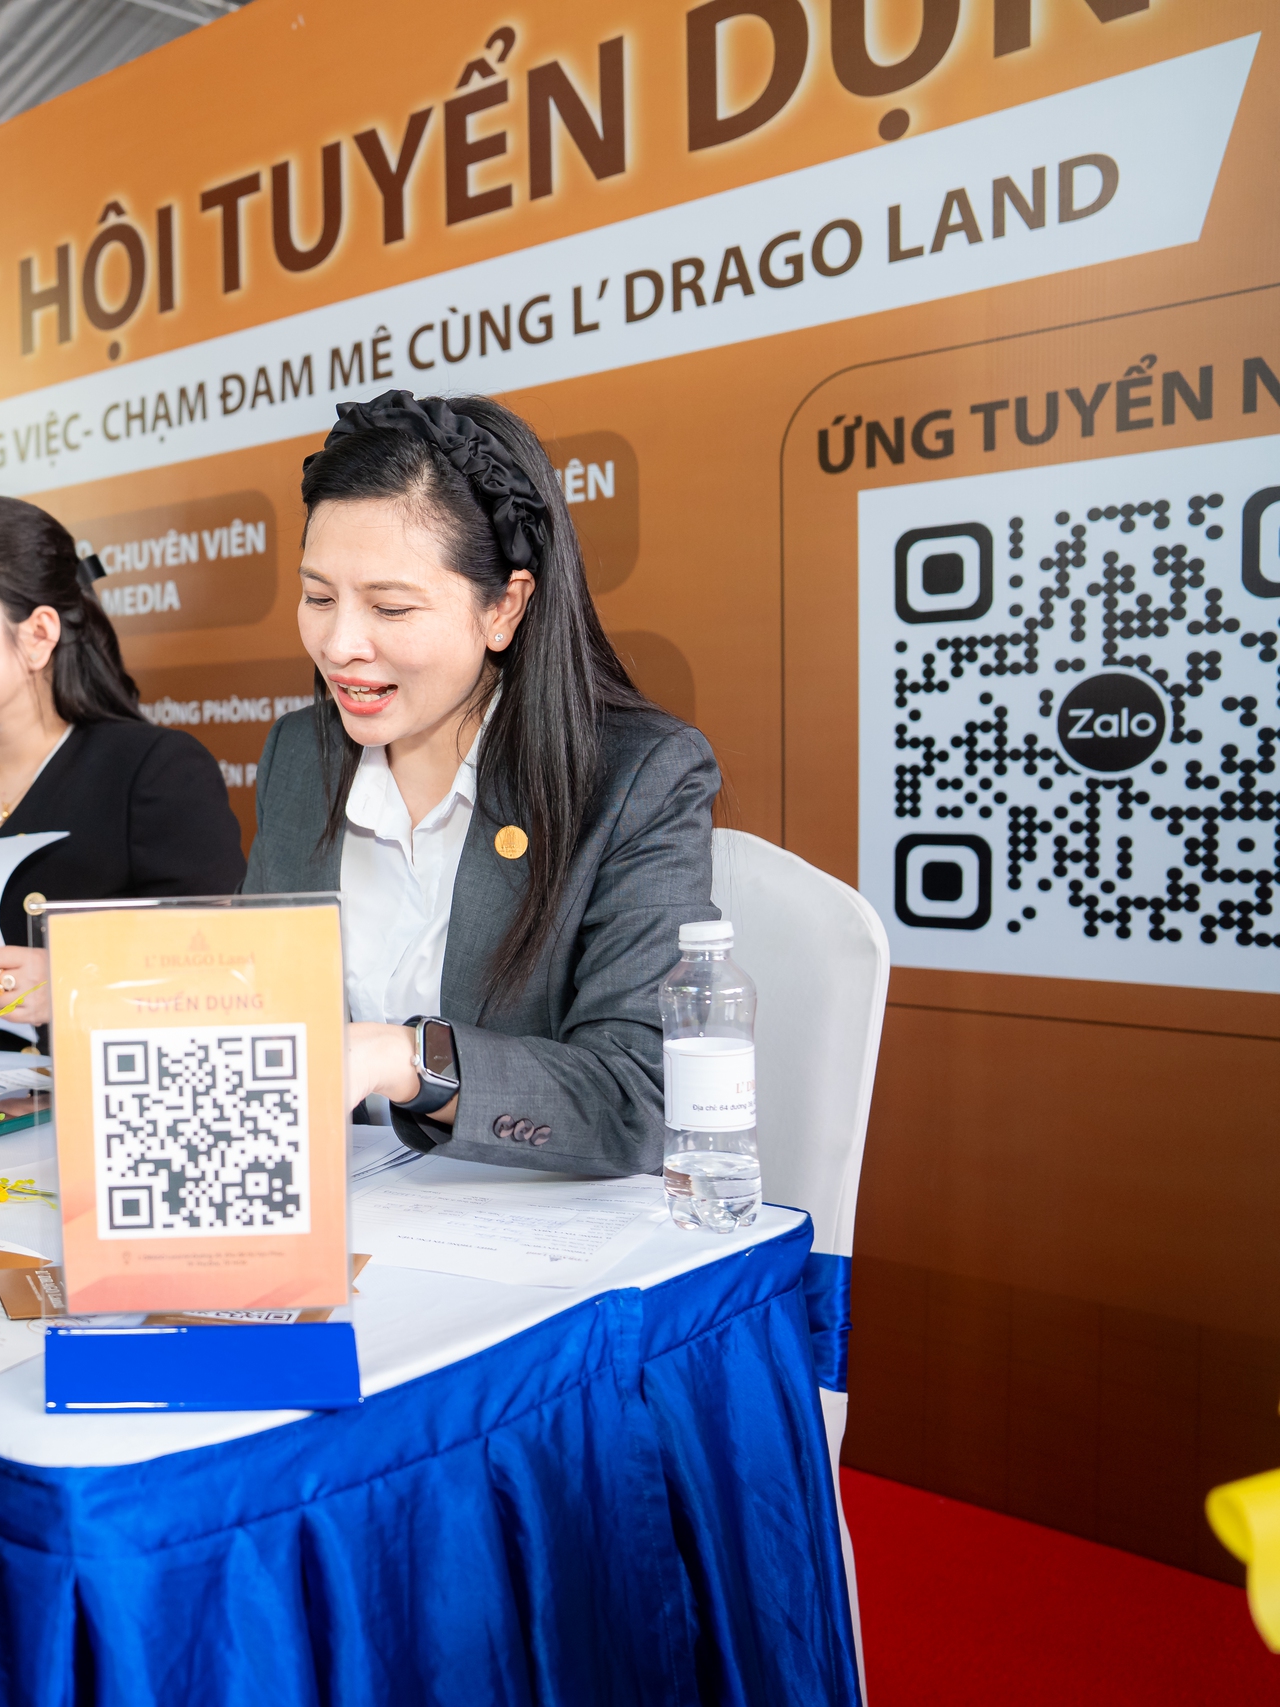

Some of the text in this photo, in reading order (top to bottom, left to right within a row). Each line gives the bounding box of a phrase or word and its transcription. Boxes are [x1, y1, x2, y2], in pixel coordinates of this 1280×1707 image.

[19, 200, 176, 362] HỘI
[200, 26, 626, 294] TUYỂN
[101, 381, 208, 445] CHẠM
[220, 356, 315, 417] ĐAM
[328, 325, 394, 391] MÊ
[407, 294, 554, 370] CÙNG
[624, 219, 863, 323] DRAGO
[887, 153, 1120, 263] LAND
[817, 413, 955, 475] ỨNG
[969, 353, 1214, 452] TUYỂN
[100, 529, 199, 575] CHUYÊN
[202, 518, 266, 561] VIÊN
[101, 580, 180, 616] MEDIA
[202, 694, 270, 723] PHÒNG
[1066, 706, 1157, 741] Zalo
[205, 992, 264, 1015] DỤNG
